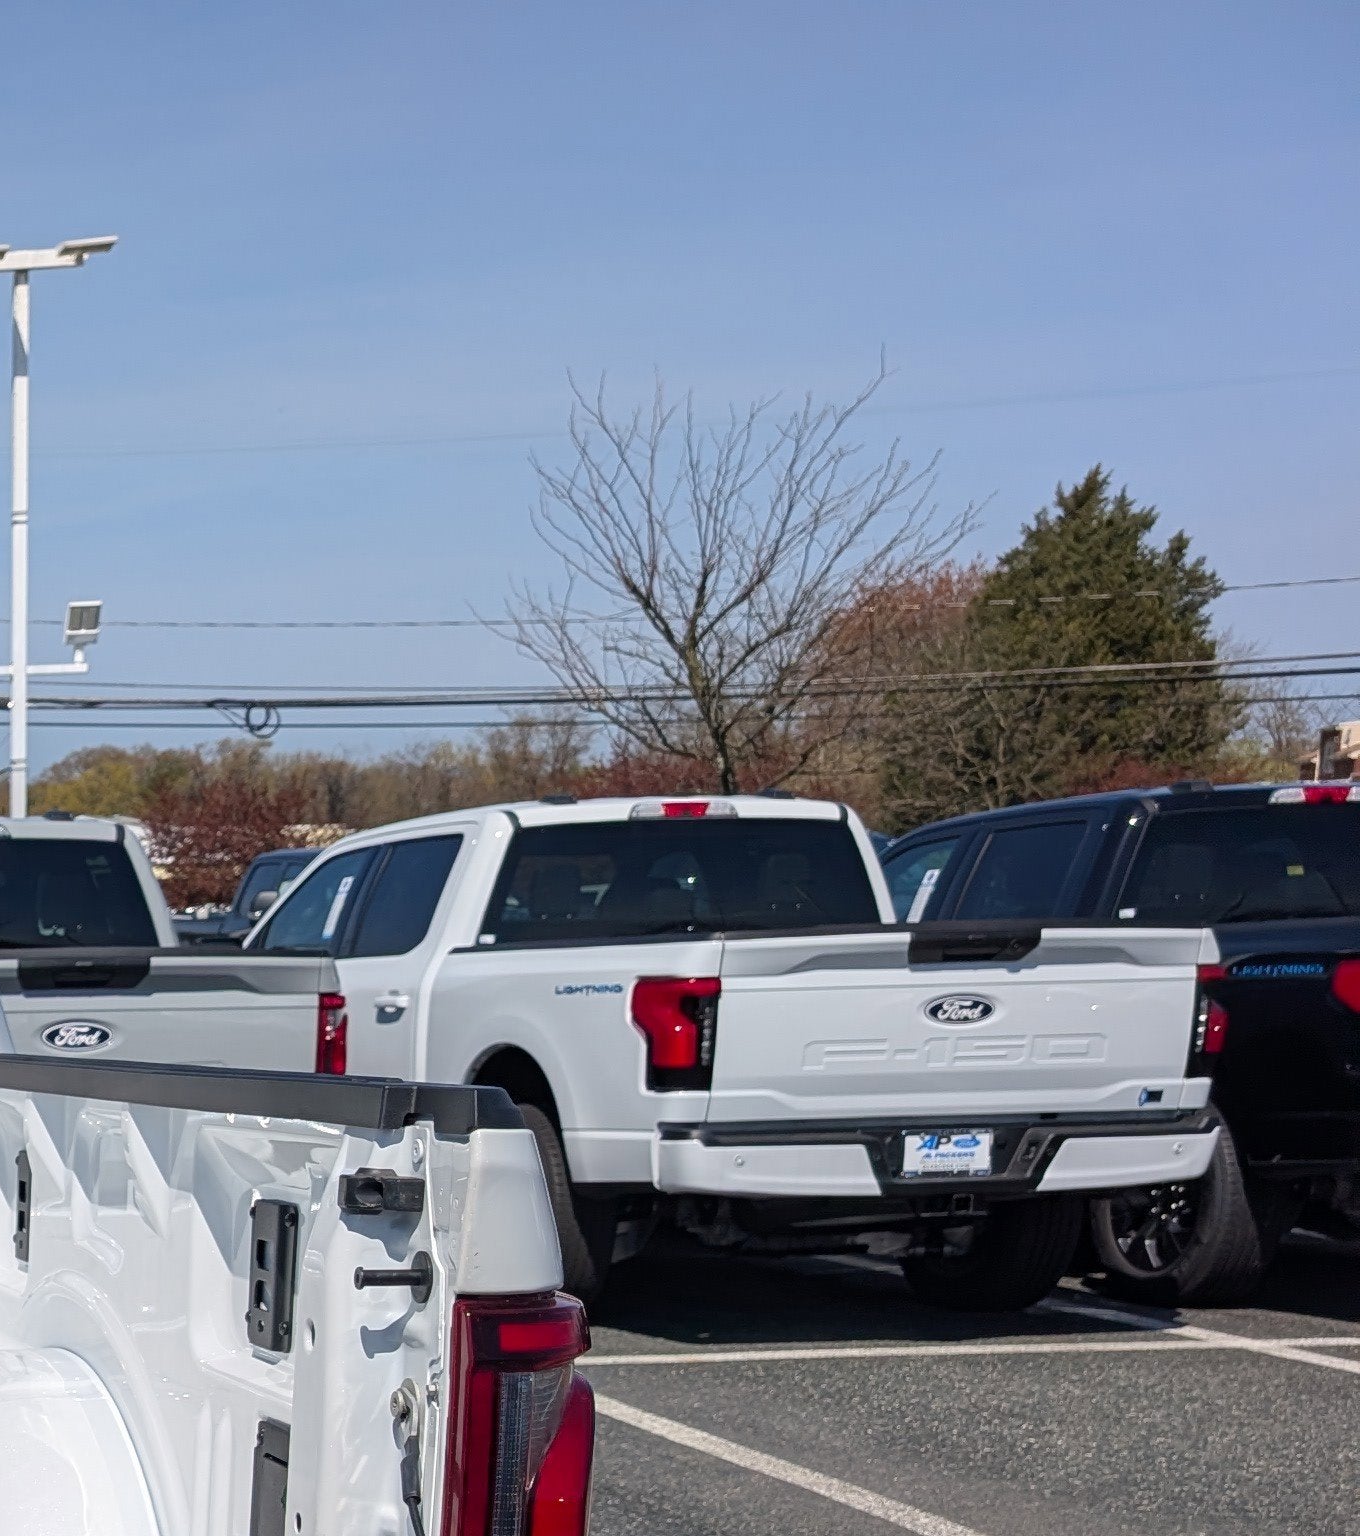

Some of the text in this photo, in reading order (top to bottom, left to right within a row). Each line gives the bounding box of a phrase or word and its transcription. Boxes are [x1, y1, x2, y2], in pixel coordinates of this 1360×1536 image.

[937, 1000, 984, 1020] Ford
[54, 1025, 102, 1046] Ford
[802, 1033, 1108, 1071] F-150
